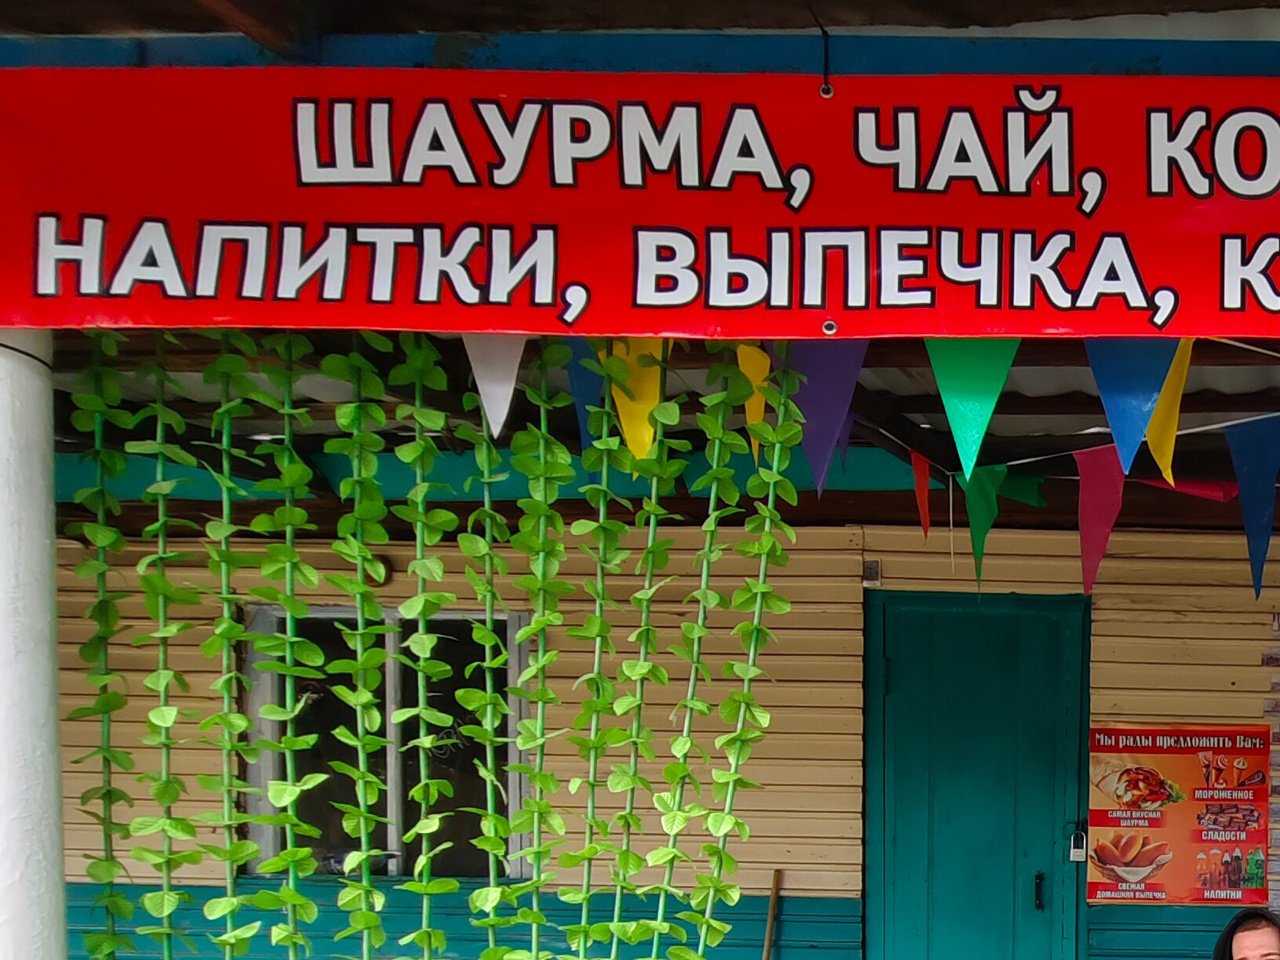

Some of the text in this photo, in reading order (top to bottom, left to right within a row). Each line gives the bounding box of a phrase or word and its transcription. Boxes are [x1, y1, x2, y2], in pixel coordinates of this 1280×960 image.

[294, 100, 813, 211] ШАУРМА,
[855, 87, 1105, 216] ЧАЙ,
[34, 213, 590, 326] НАПИТКИ,
[633, 227, 1178, 329] ВЫПЕЧКА,
[1095, 732, 1264, 749] Мы рады предложить Вам:
[1194, 789, 1254, 800] МОРОЖЕННОЕ
[1108, 810, 1131, 818] САМАЯ
[1120, 819, 1149, 827] ШАУРМА
[1201, 830, 1247, 841] СЛАДОСТИ
[1117, 882, 1145, 890] СВЕЖАЯ
[1135, 891, 1167, 899] ВЫПЕЧКА
[1204, 889, 1243, 899] НАПИТКИ
